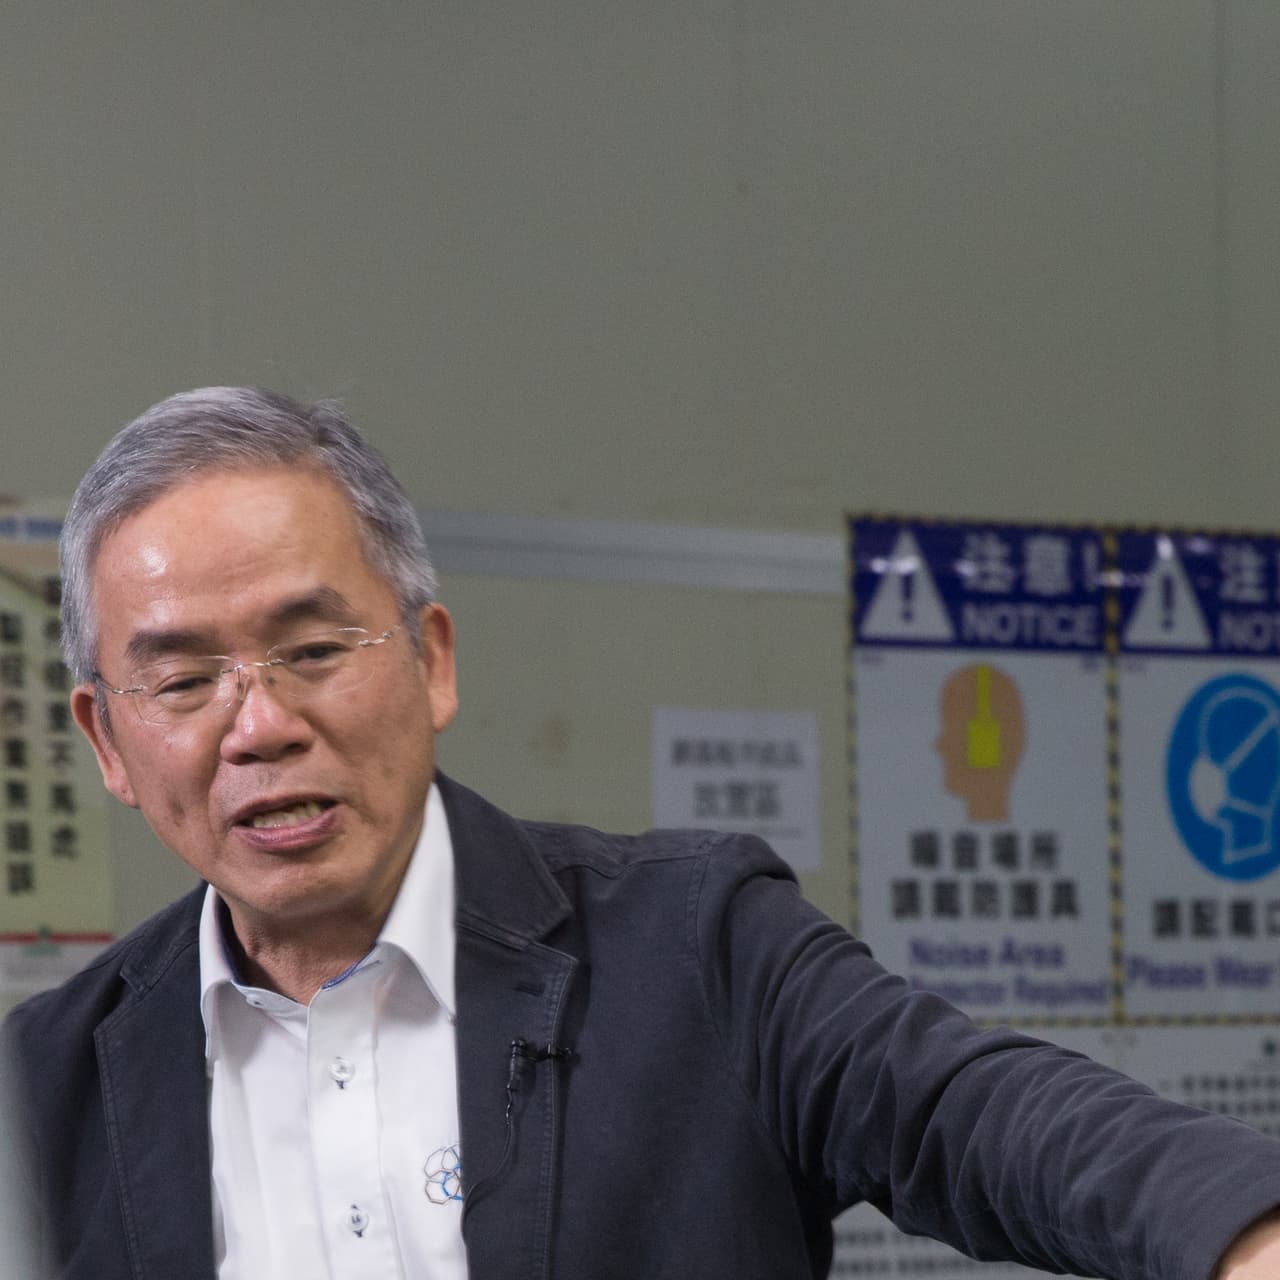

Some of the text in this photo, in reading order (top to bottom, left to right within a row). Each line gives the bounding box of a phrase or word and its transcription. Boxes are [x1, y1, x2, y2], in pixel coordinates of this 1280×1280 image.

[961, 604, 1098, 646] NOTICE
[909, 936, 1065, 969] Noise Area
[1127, 956, 1205, 987] Please
[1215, 956, 1272, 987] Wear
